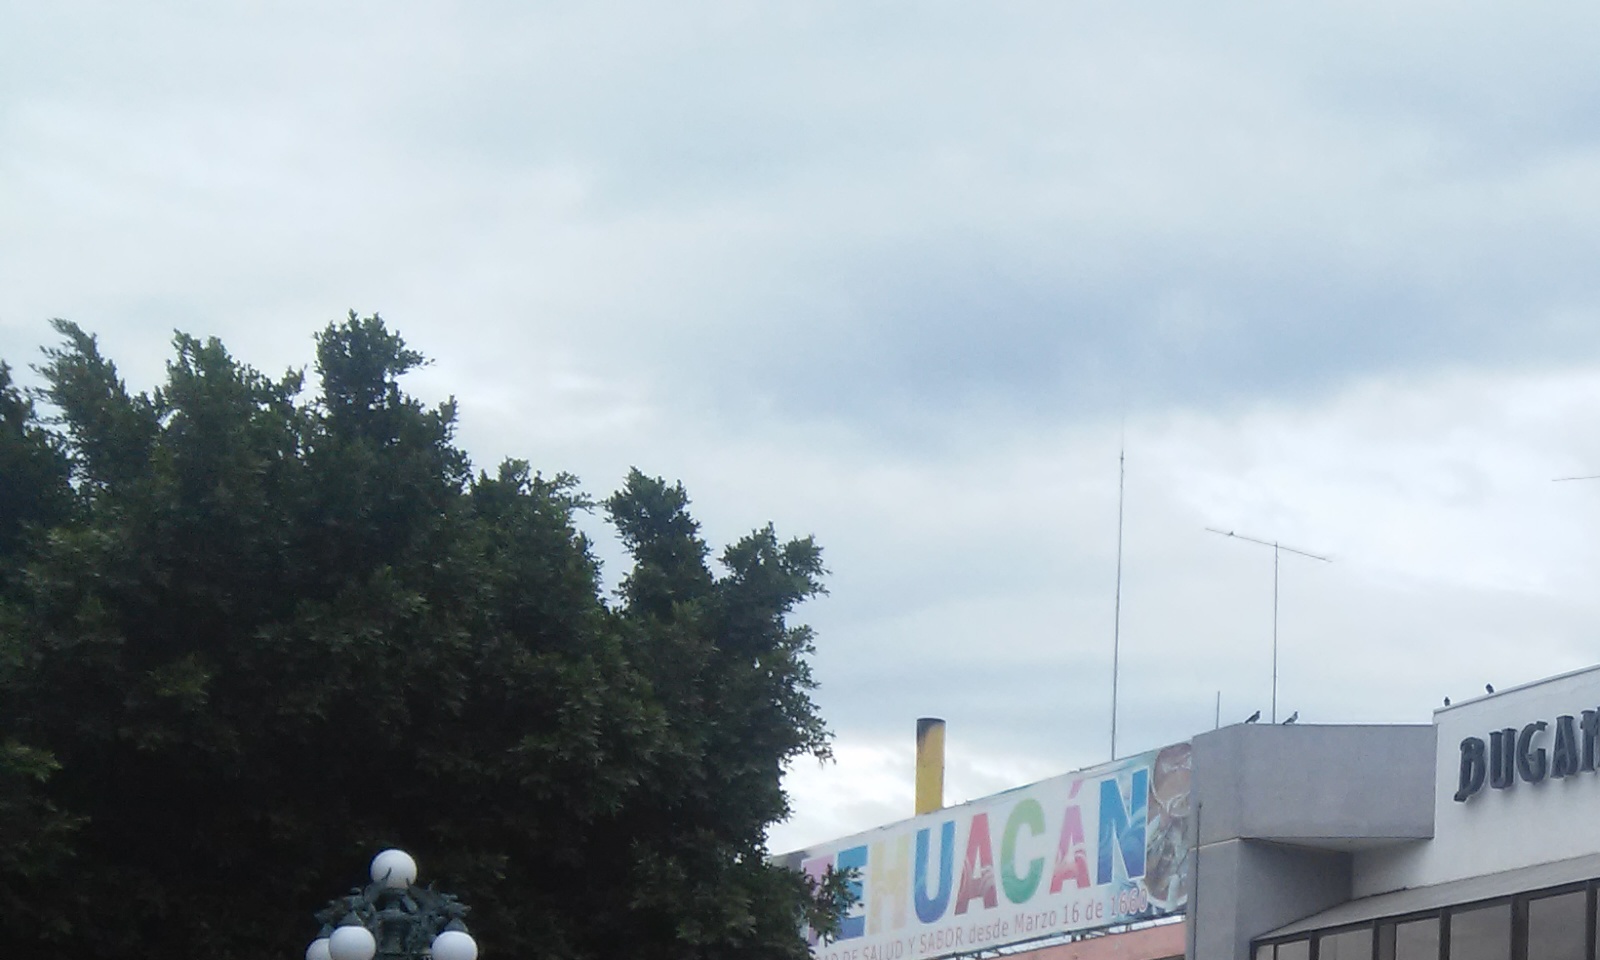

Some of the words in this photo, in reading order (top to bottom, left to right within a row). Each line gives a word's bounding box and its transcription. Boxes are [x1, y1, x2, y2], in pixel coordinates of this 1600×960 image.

[908, 935, 916, 953] Y
[919, 928, 964, 954] SABOR
[969, 918, 1009, 944] desde
[1014, 911, 1057, 935] Marzo
[1064, 903, 1080, 925] 16
[1086, 898, 1103, 921] de
[1111, 887, 1149, 917] 1660
